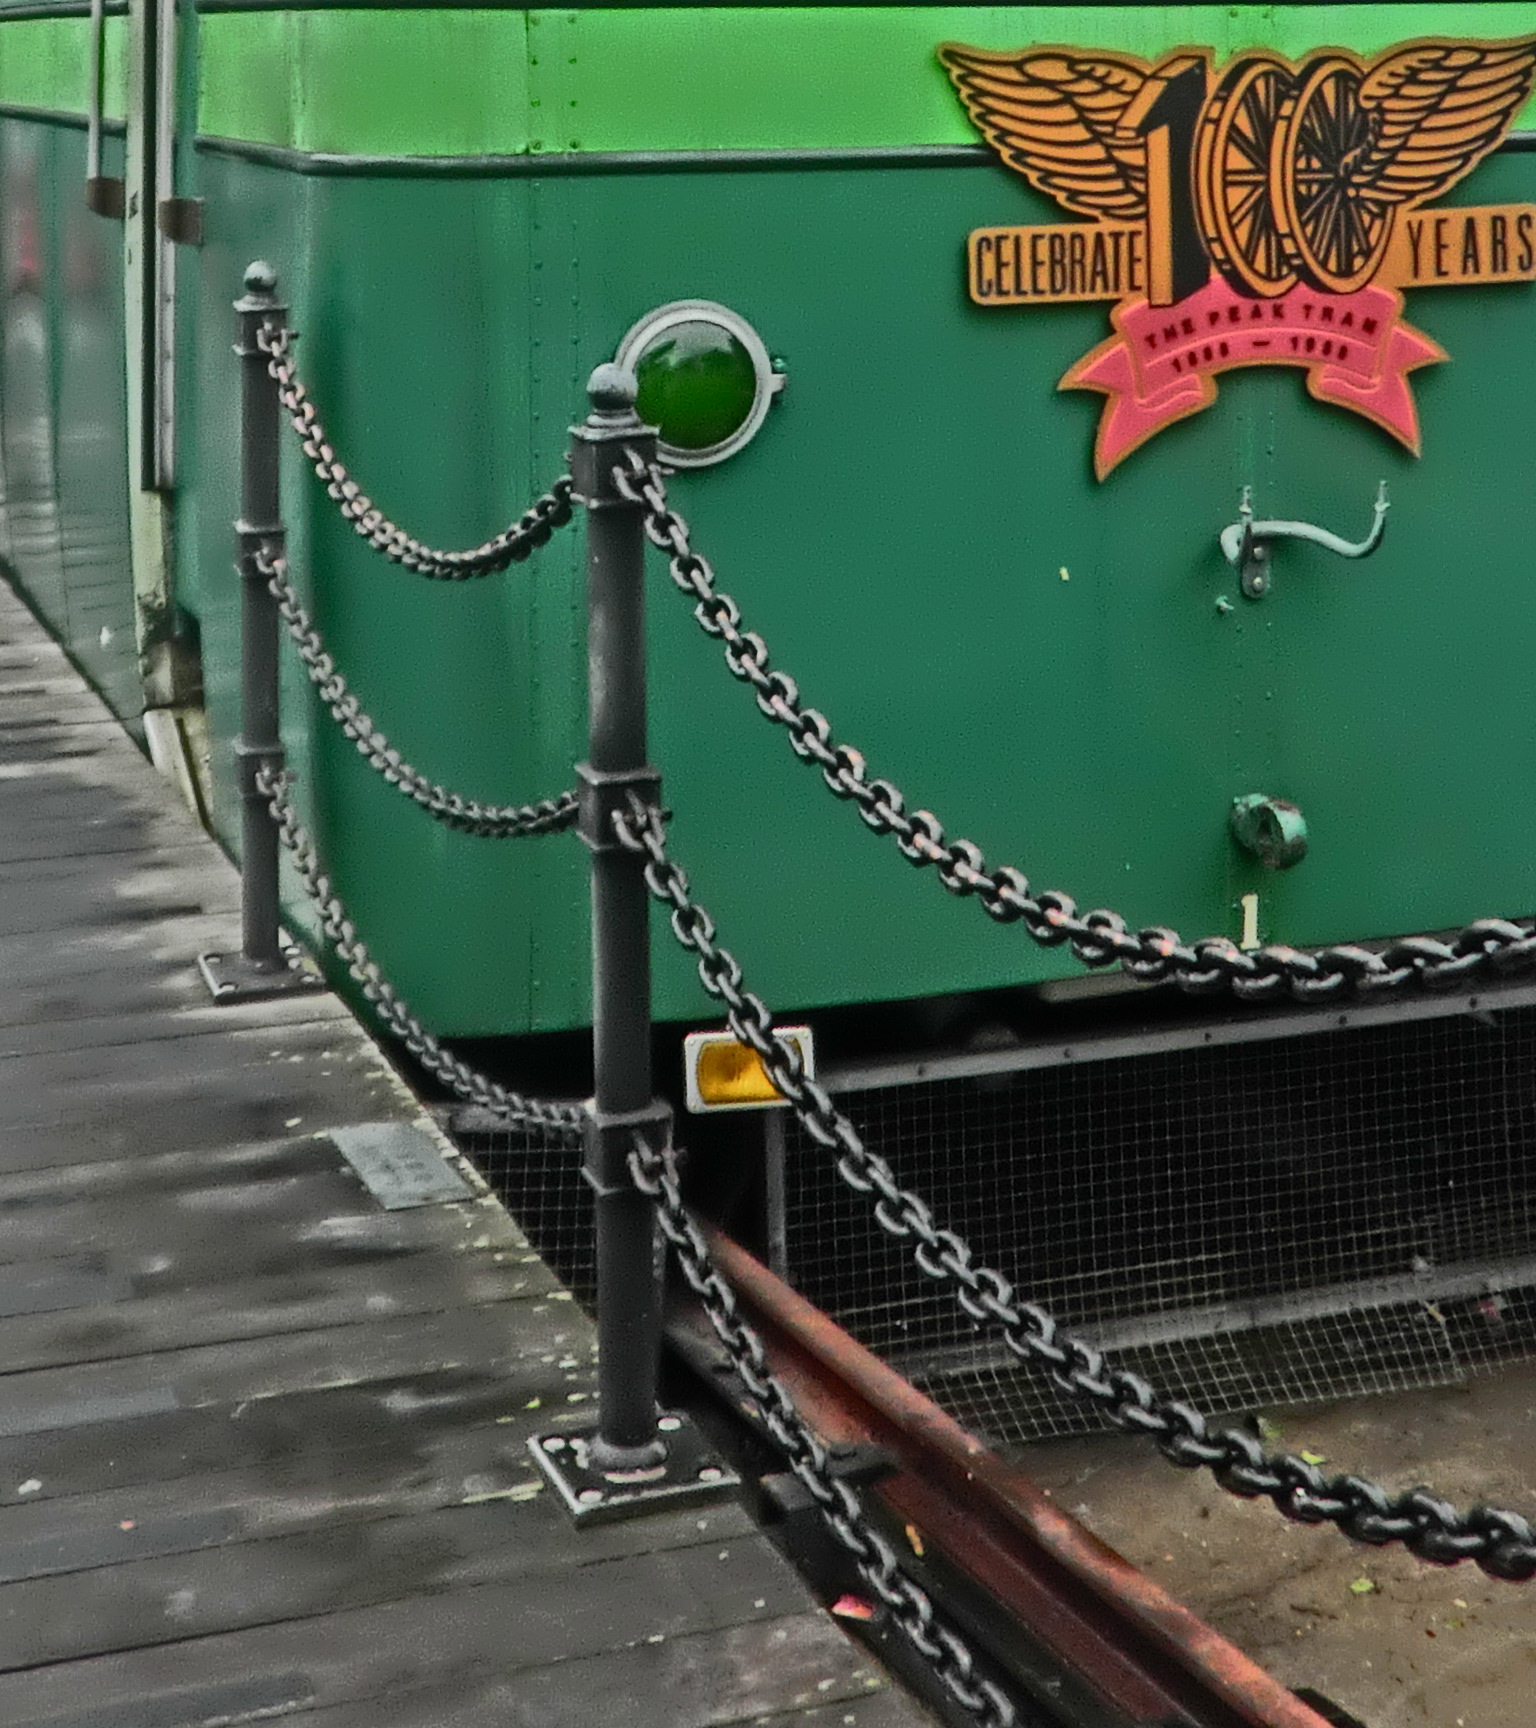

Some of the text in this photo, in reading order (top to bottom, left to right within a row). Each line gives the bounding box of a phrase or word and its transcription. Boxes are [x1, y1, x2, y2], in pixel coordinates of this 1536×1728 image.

[975, 54, 1534, 308] CELEBRATE 100 YEARS
[1144, 302, 1379, 350] THE PEAK TRAM
